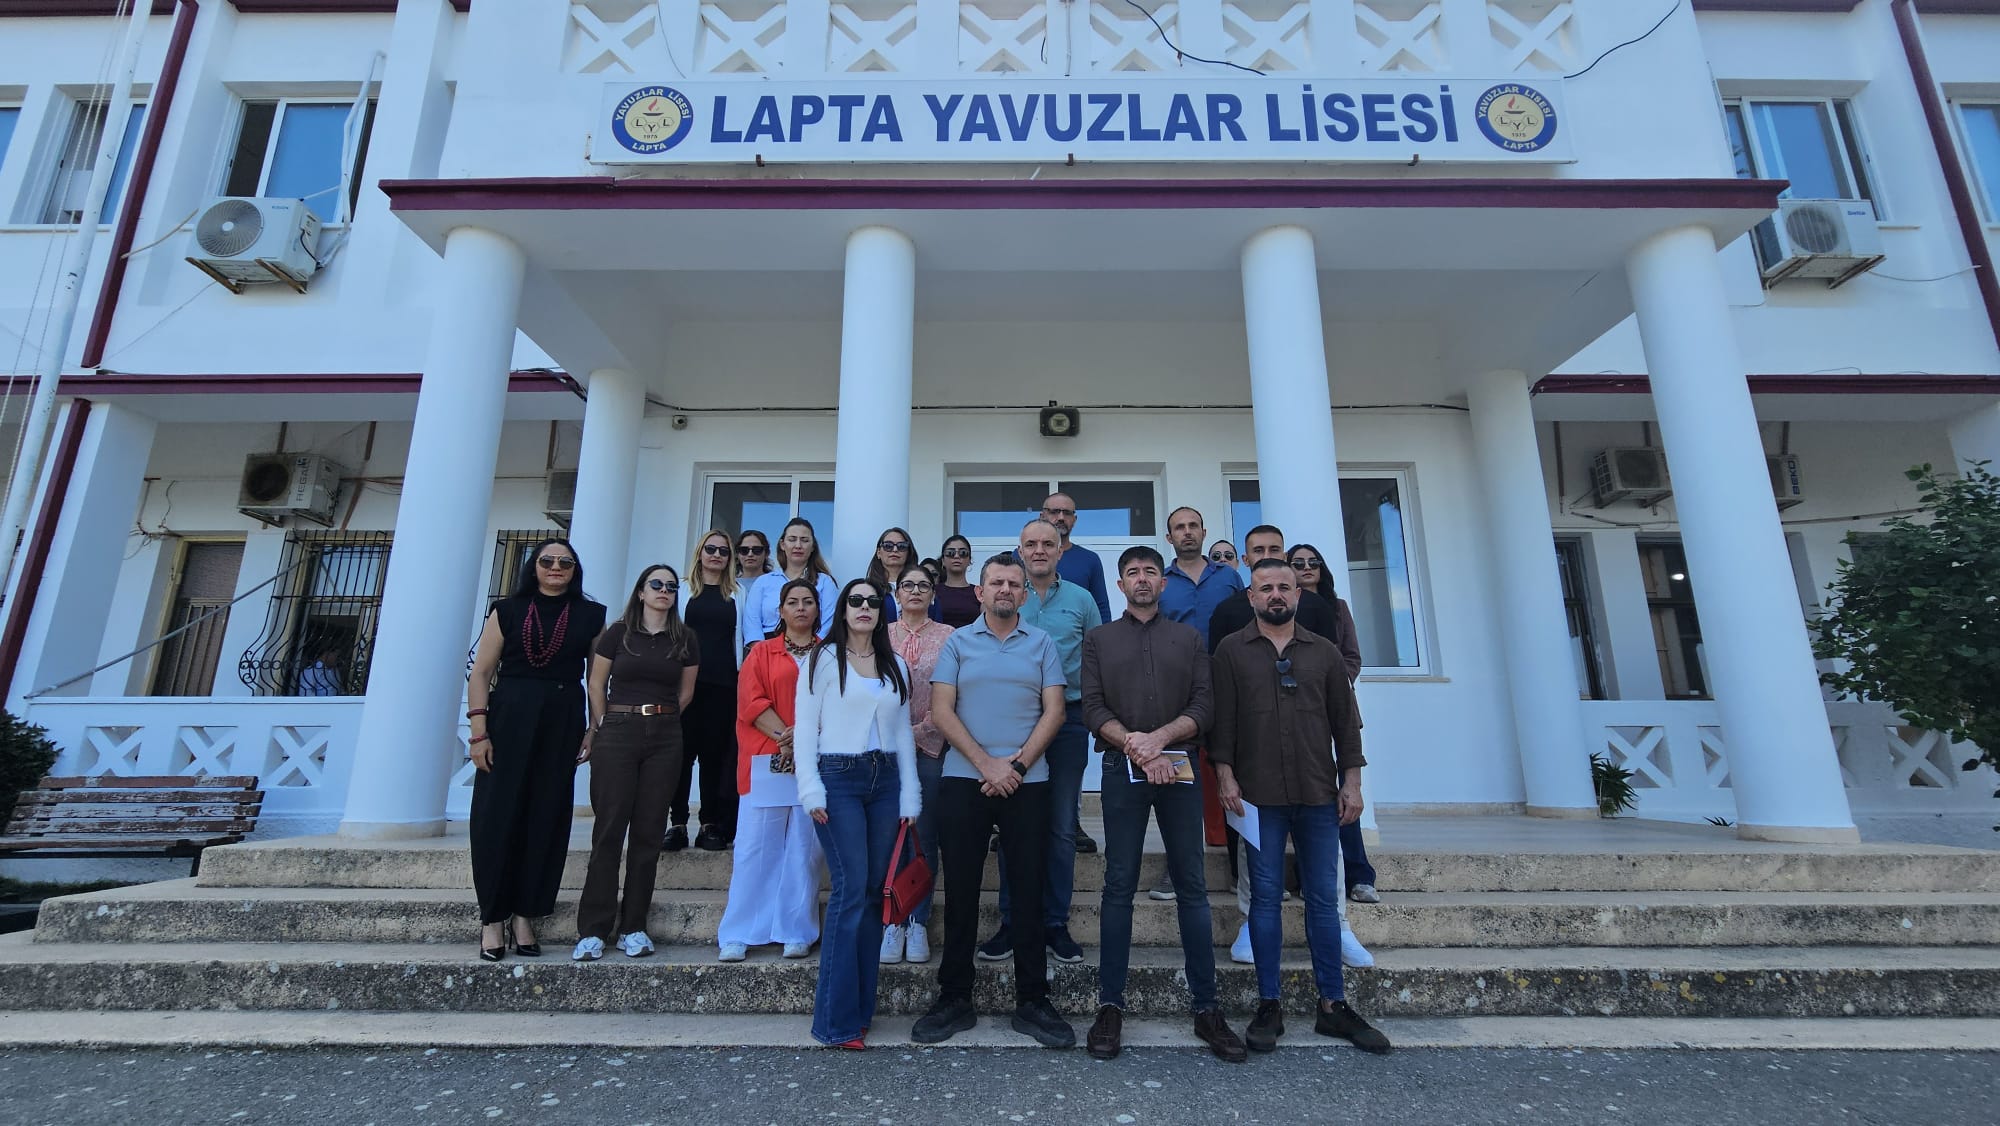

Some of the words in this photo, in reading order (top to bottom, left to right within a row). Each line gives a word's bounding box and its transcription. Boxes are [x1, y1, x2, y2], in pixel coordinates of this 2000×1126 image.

[615, 89, 663, 120] YAVUZLAR
[668, 91, 691, 118] LİSESİ
[710, 94, 904, 143] LAPTA
[923, 93, 1248, 143] YAVUZLAR
[1265, 84, 1459, 143] LİSESİ
[1478, 86, 1519, 118] YAVUZLAR
[1524, 88, 1554, 117] LİSESİ
[632, 142, 667, 151] LAPTA
[1503, 140, 1537, 149] LAPTA
